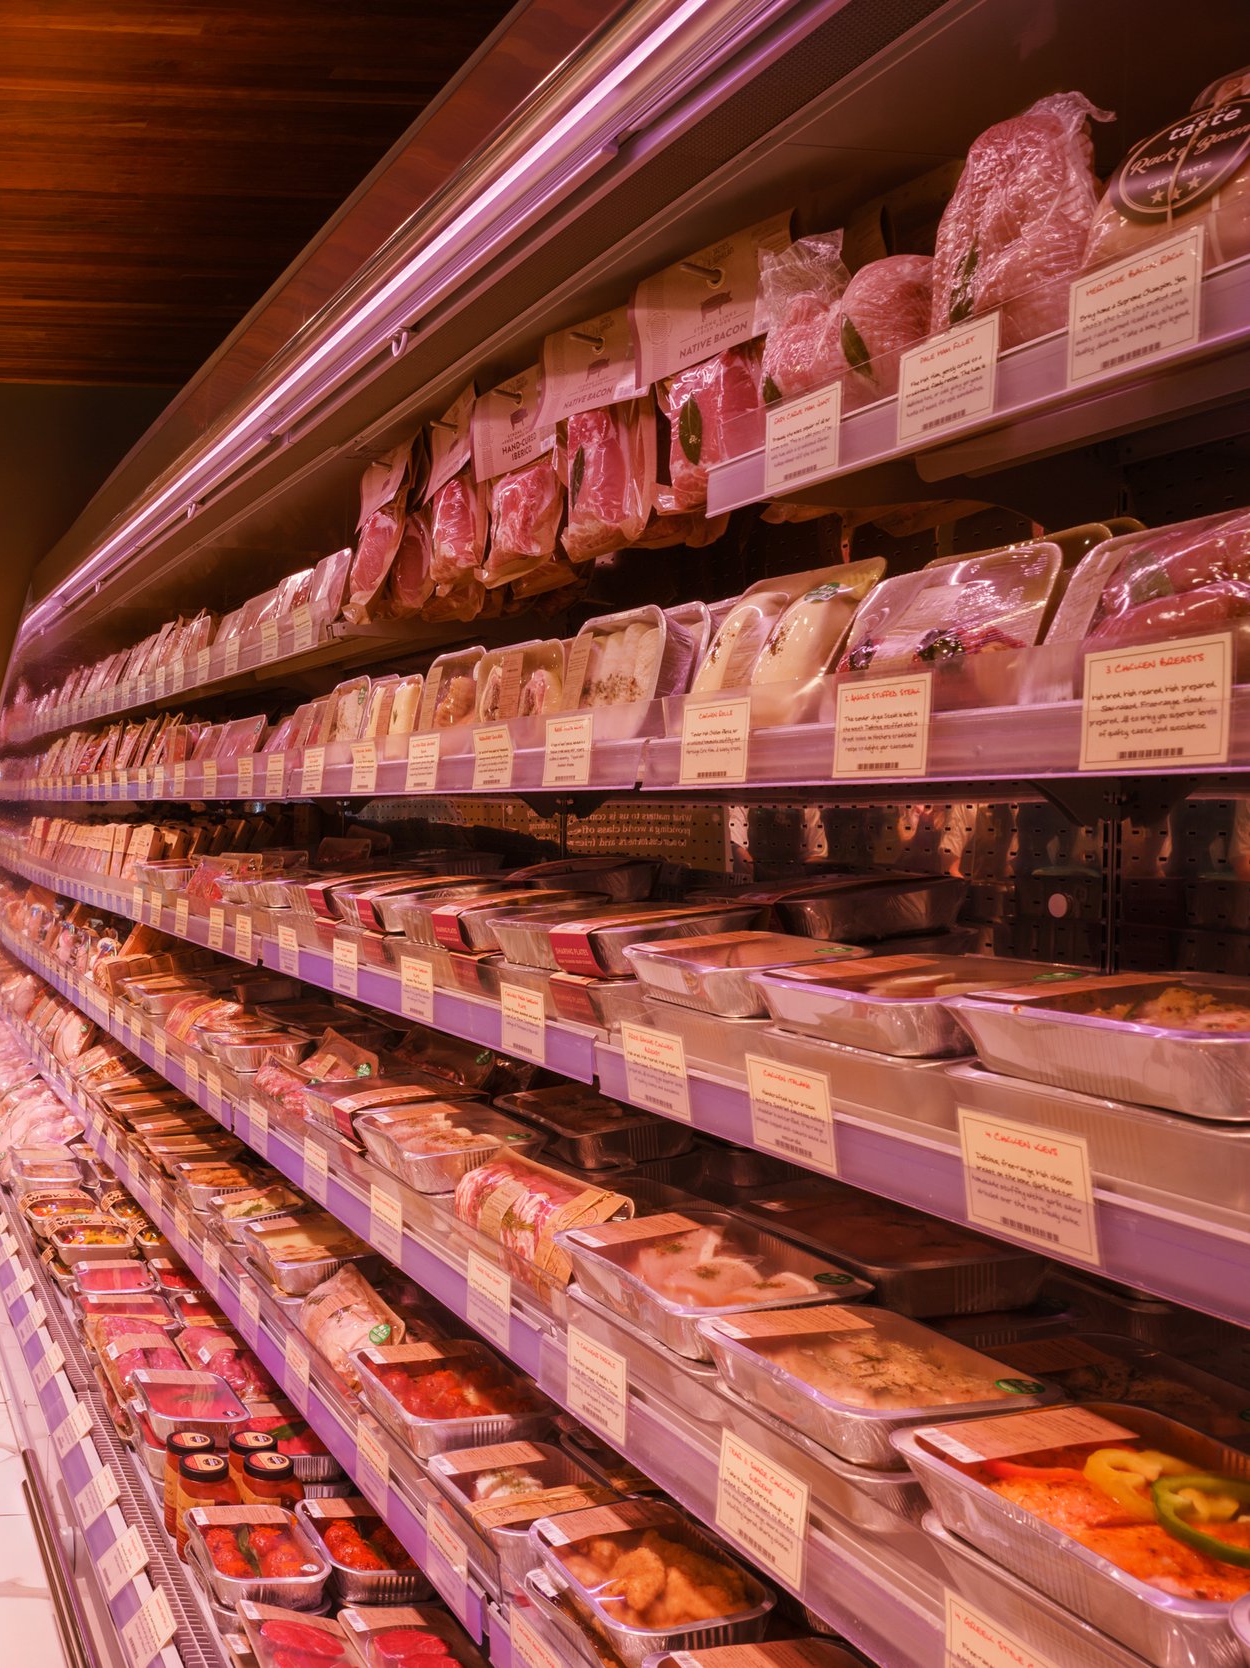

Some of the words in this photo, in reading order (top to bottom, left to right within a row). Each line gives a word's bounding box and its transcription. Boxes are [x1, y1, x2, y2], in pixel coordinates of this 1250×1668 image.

[1129, 146, 1177, 175] Rack
[679, 337, 712, 359] NATIVE
[714, 321, 748, 343] BACON
[563, 395, 586, 410] NATIVE
[587, 386, 614, 401] BACON
[502, 432, 537, 455] HAND-CURED
[1114, 659, 1155, 673] CHICKEN
[1159, 652, 1204, 667] BREASTS
[555, 947, 575, 956] SHARING
[576, 949, 589, 957] PLATES
[993, 1131, 1030, 1149] CHICKEN
